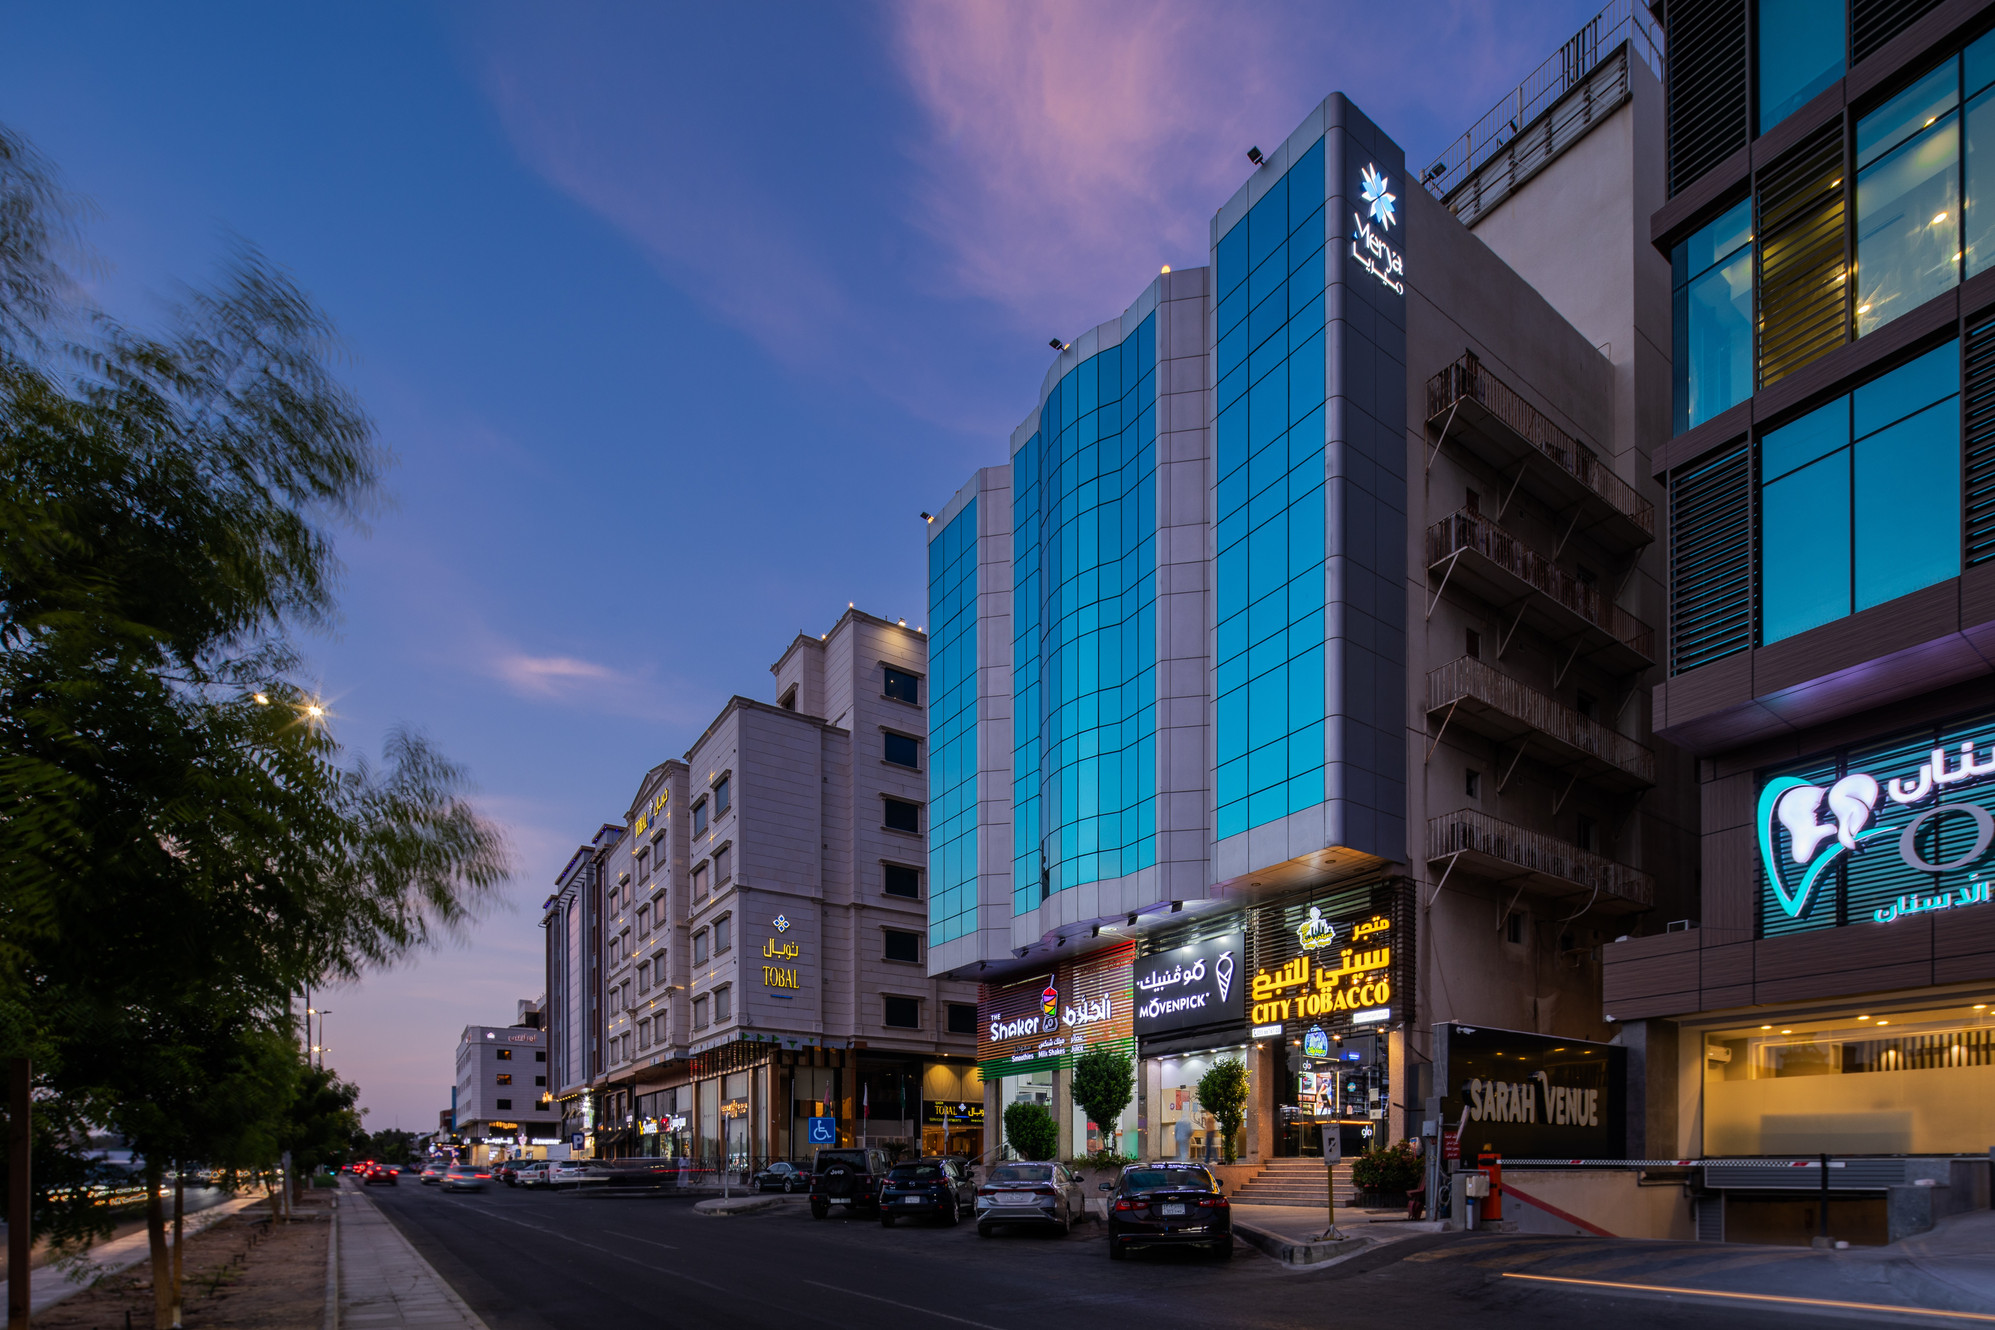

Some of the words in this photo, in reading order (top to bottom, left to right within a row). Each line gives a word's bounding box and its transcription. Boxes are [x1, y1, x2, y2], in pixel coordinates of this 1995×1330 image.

[1354, 212, 1404, 276] Merya
[1352, 915, 1390, 942] متجر
[763, 938, 799, 960] توبال
[762, 965, 800, 989] TOBAL
[1252, 956, 1310, 1001] للتبغ
[1316, 947, 1390, 993] سيتي
[1251, 999, 1292, 1025] CITY
[1295, 982, 1390, 1018] TOBACCO
[990, 1013, 1001, 1021] THE
[990, 1017, 1040, 1042] Shaker
[1011, 1053, 1034, 1063] Smoothies
[1038, 1050, 1048, 1058] Milk
[1048, 1048, 1066, 1057] Shakes
[1070, 1045, 1084, 1053] Juice
[1468, 1078, 1535, 1124] SARAH
[1536, 1070, 1599, 1127] VENUE
[935, 1105, 957, 1116] TOBAL
[968, 1107, 984, 1117] وبال
[573, 1134, 584, 1150] P
